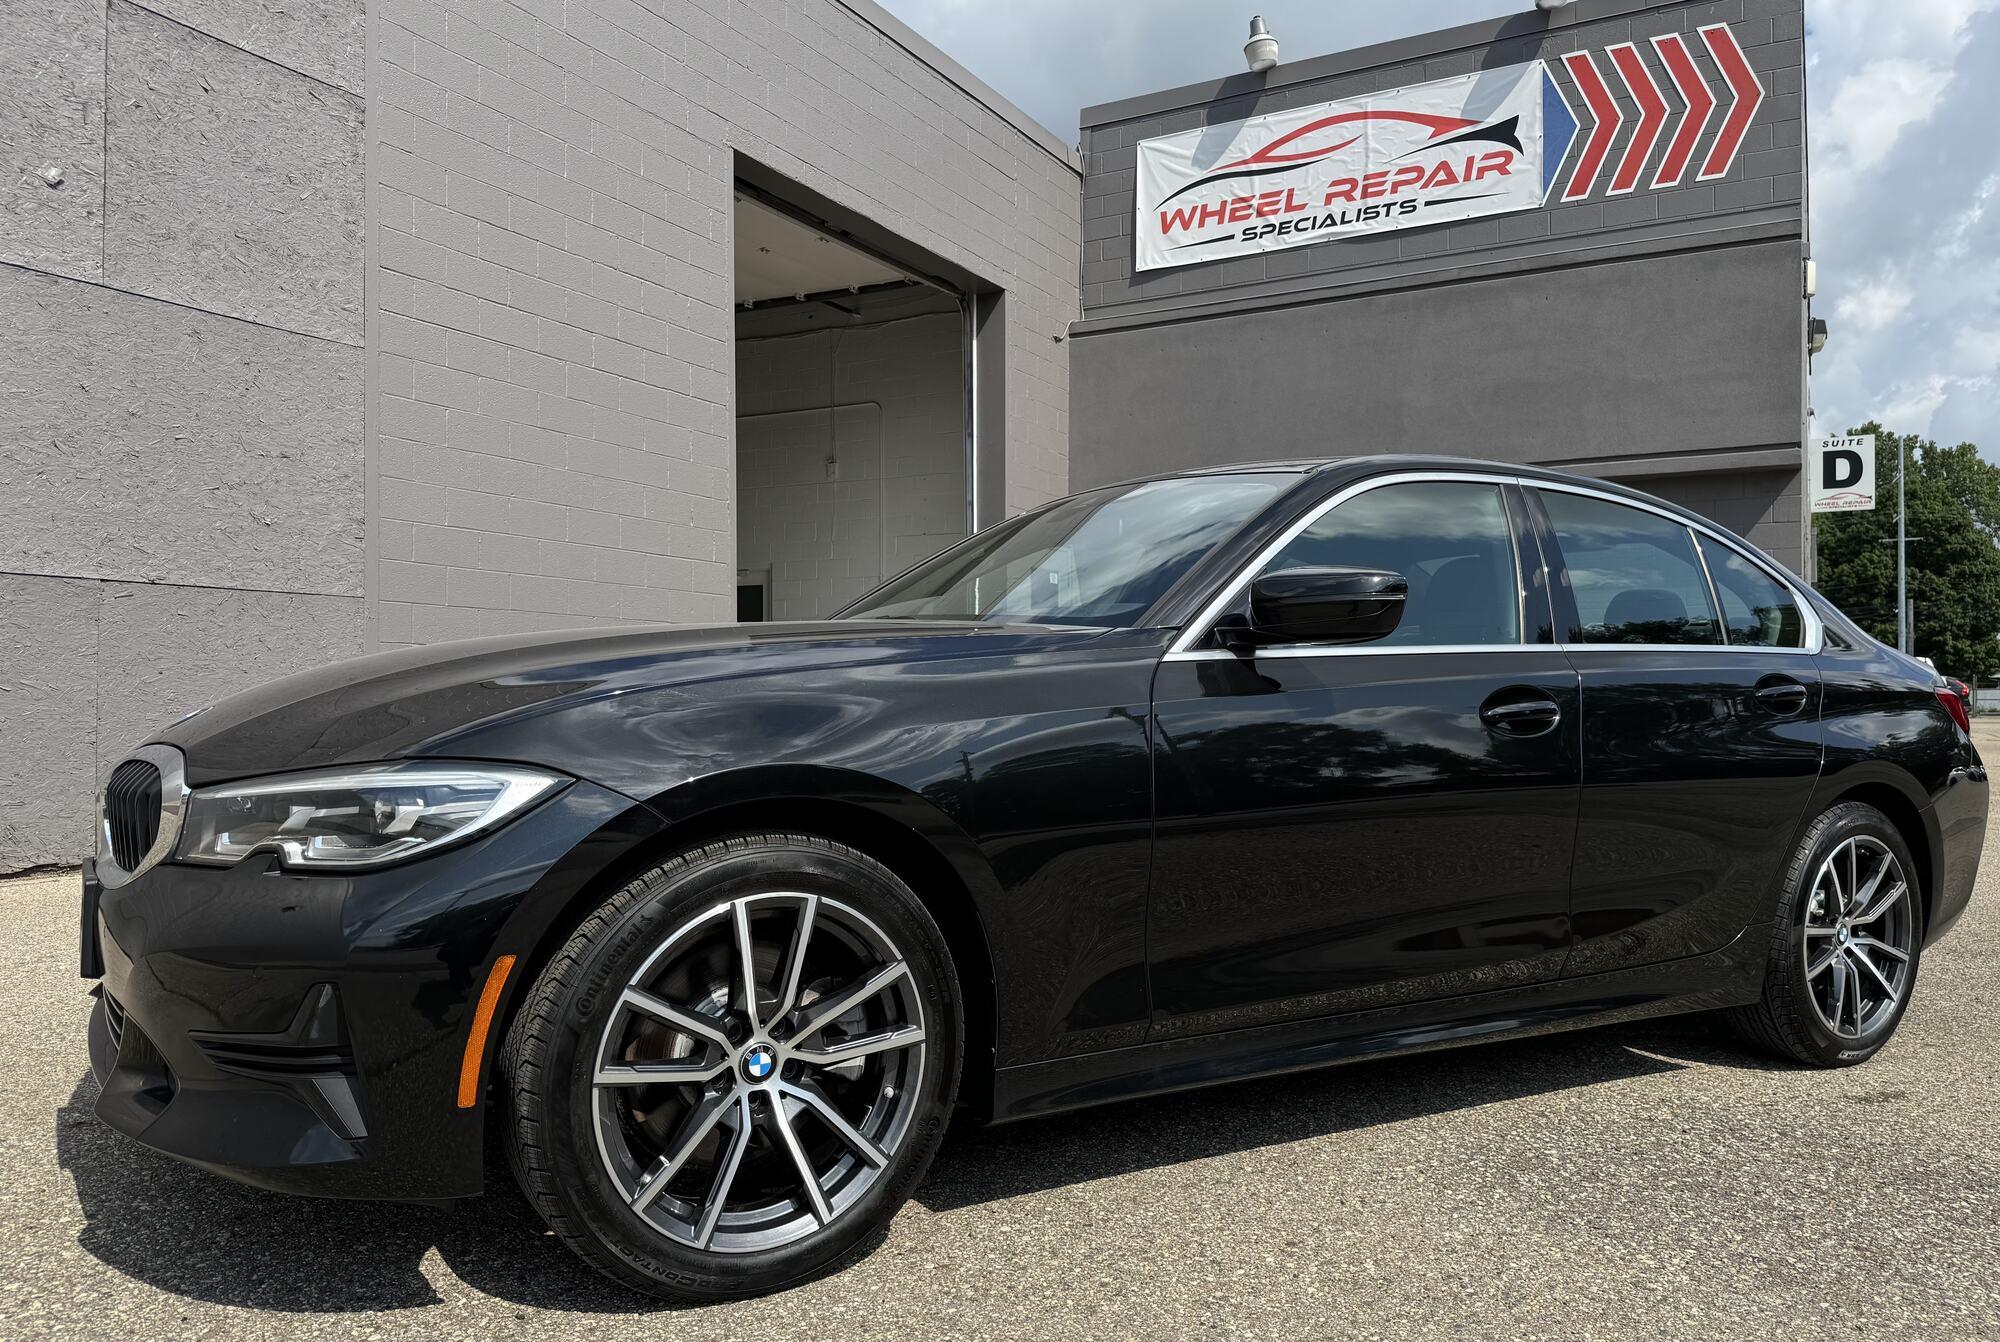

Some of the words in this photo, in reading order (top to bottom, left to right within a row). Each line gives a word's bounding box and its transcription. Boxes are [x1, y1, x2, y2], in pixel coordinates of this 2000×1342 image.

[1160, 187, 1308, 235] WHEEL
[1324, 150, 1514, 206] REPAIR
[1241, 199, 1418, 242] SPECIALISTS
[1822, 438, 1864, 448] SUITE
[1822, 449, 1863, 489] D
[576, 922, 645, 1017] Continental
[745, 1045, 775, 1060] BMW
